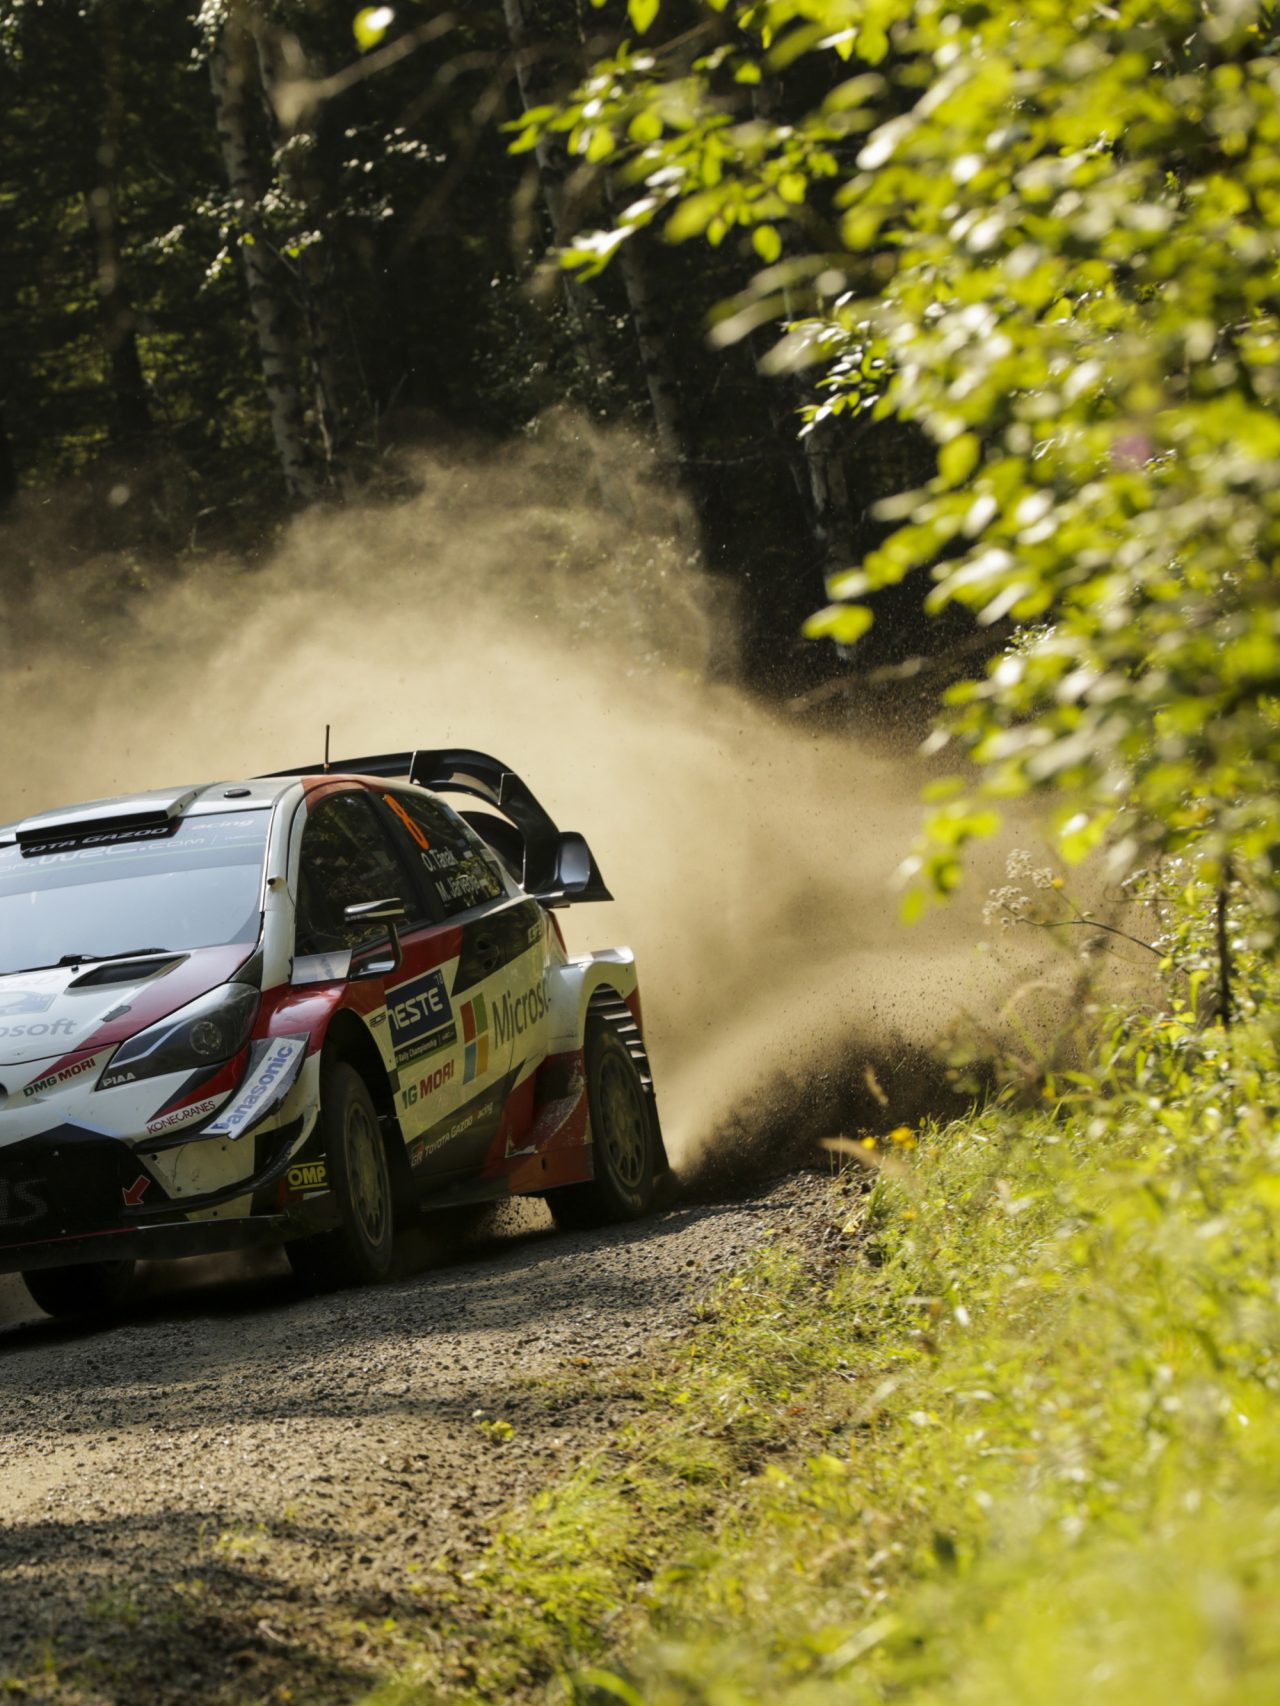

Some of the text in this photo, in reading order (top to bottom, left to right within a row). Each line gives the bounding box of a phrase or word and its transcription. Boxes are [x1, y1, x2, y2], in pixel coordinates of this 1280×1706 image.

[81, 826, 169, 845] GAZOO
[23, 1057, 97, 1098] DMG MORI
[102, 1071, 137, 1087] PIAA
[420, 1059, 454, 1099] MORI
[146, 1099, 216, 1135] KONECRANES
[287, 1165, 327, 1187] OMP
